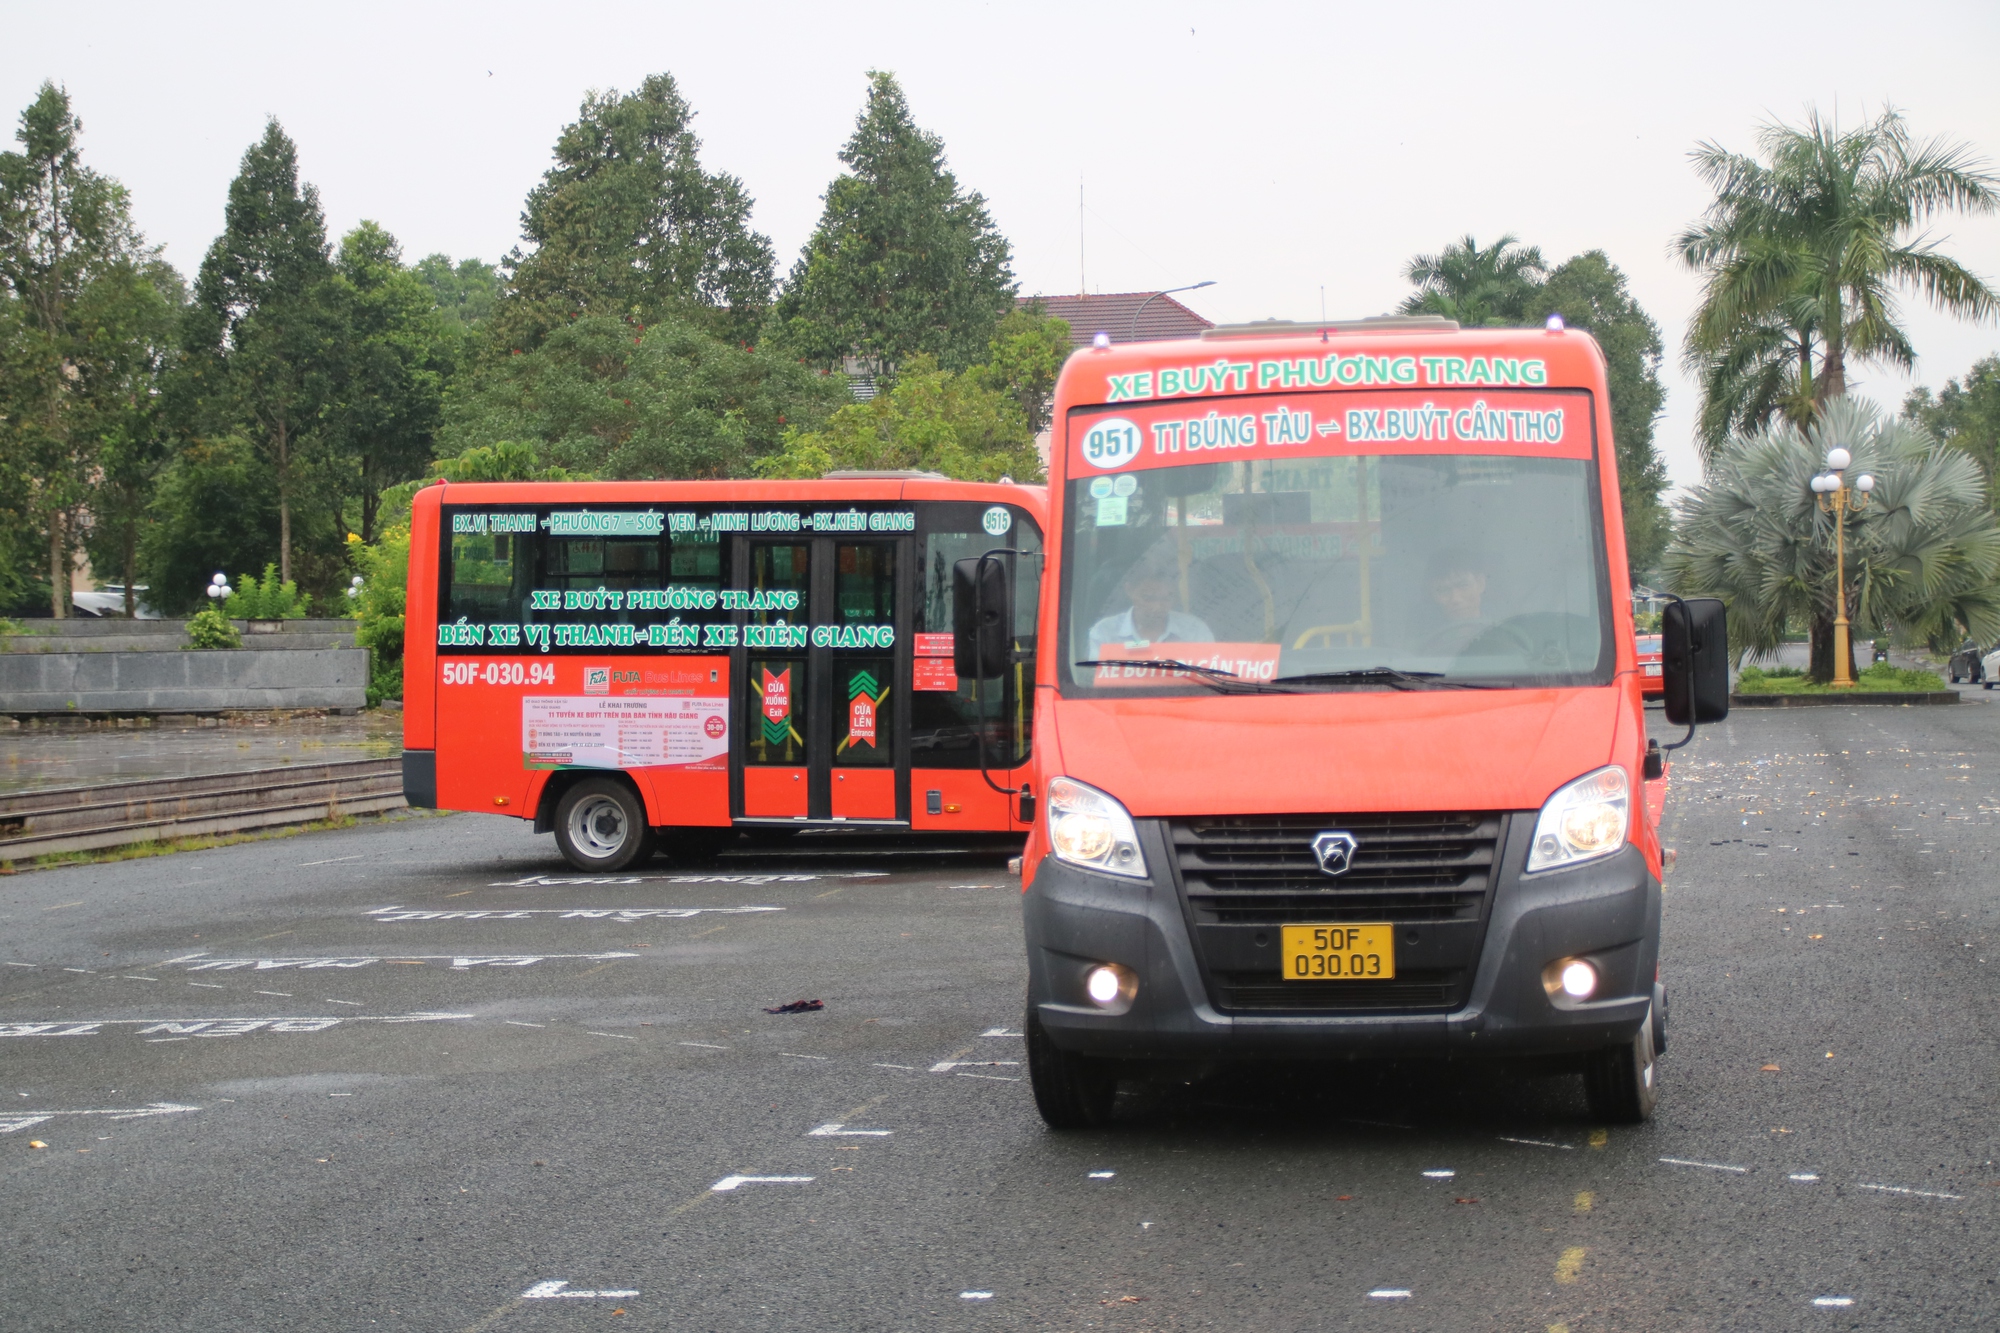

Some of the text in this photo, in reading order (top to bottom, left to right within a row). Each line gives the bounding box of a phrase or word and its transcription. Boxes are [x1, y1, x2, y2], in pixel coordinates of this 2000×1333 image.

[1107, 355, 1547, 402] XE BUÝT PHƯƠNG TRANG
[1153, 401, 1563, 453] TT BÚNG TÀU BX.BUÝT CẦN THƠ
[1089, 427, 1134, 459] 951
[453, 508, 915, 535] BX.VỊ THANH PHƯỜNG 7 SÓC VEN MINH LƯƠNG BX.KIÊN GIANG
[986, 512, 1008, 530] 9515
[531, 587, 799, 610] XE BUÝT PHƯƠNG TRANG
[438, 616, 895, 653] BẾN XE VỊ THANH BẾN XE KIÊN GIANG
[443, 663, 555, 685] 50F-030.94
[612, 671, 703, 684] FUTA Bus Lines
[1236, 660, 1275, 680] THƠ
[768, 680, 785, 693] CỬA
[765, 694, 787, 706] XUỐNG
[854, 702, 872, 715] CỬA
[769, 708, 783, 718] Exit
[854, 715, 872, 727] LÊN
[851, 729, 874, 737] Entrance
[1314, 928, 1360, 951] 50F
[1295, 954, 1381, 976] 030.03
